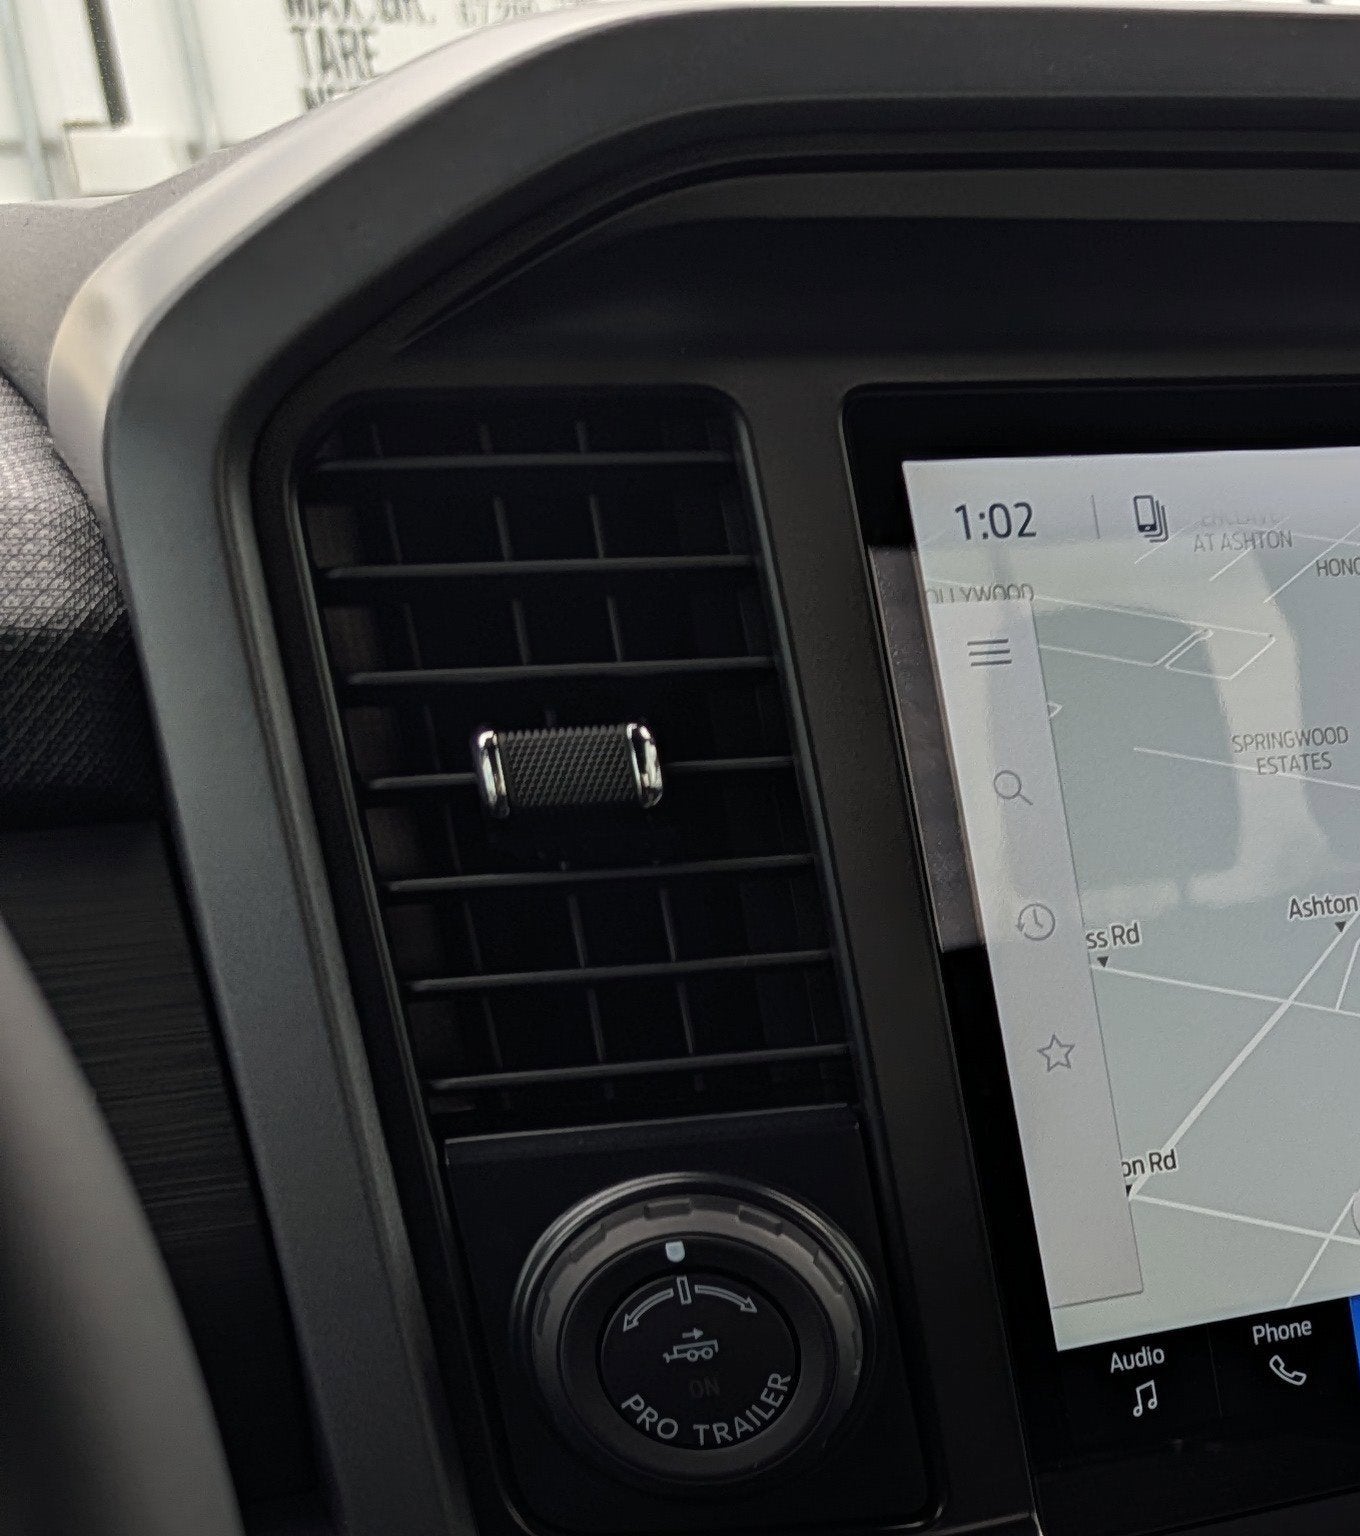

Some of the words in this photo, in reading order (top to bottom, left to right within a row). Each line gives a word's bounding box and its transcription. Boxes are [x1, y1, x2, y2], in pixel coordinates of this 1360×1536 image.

[955, 502, 1036, 540] 1:02
[1194, 533, 1214, 552] AT
[1221, 529, 1293, 551] ASHTON
[1231, 726, 1349, 754] SPRINGWOOD
[1256, 752, 1333, 777] ESTATES
[1287, 892, 1359, 921] Ashton
[1111, 922, 1140, 946] Rd
[1149, 1148, 1177, 1173] Rd
[1252, 1317, 1312, 1346] Phone
[1110, 1343, 1165, 1373] Audio
[621, 1394, 679, 1439] PRO
[692, 1373, 792, 1446] TRAILER
